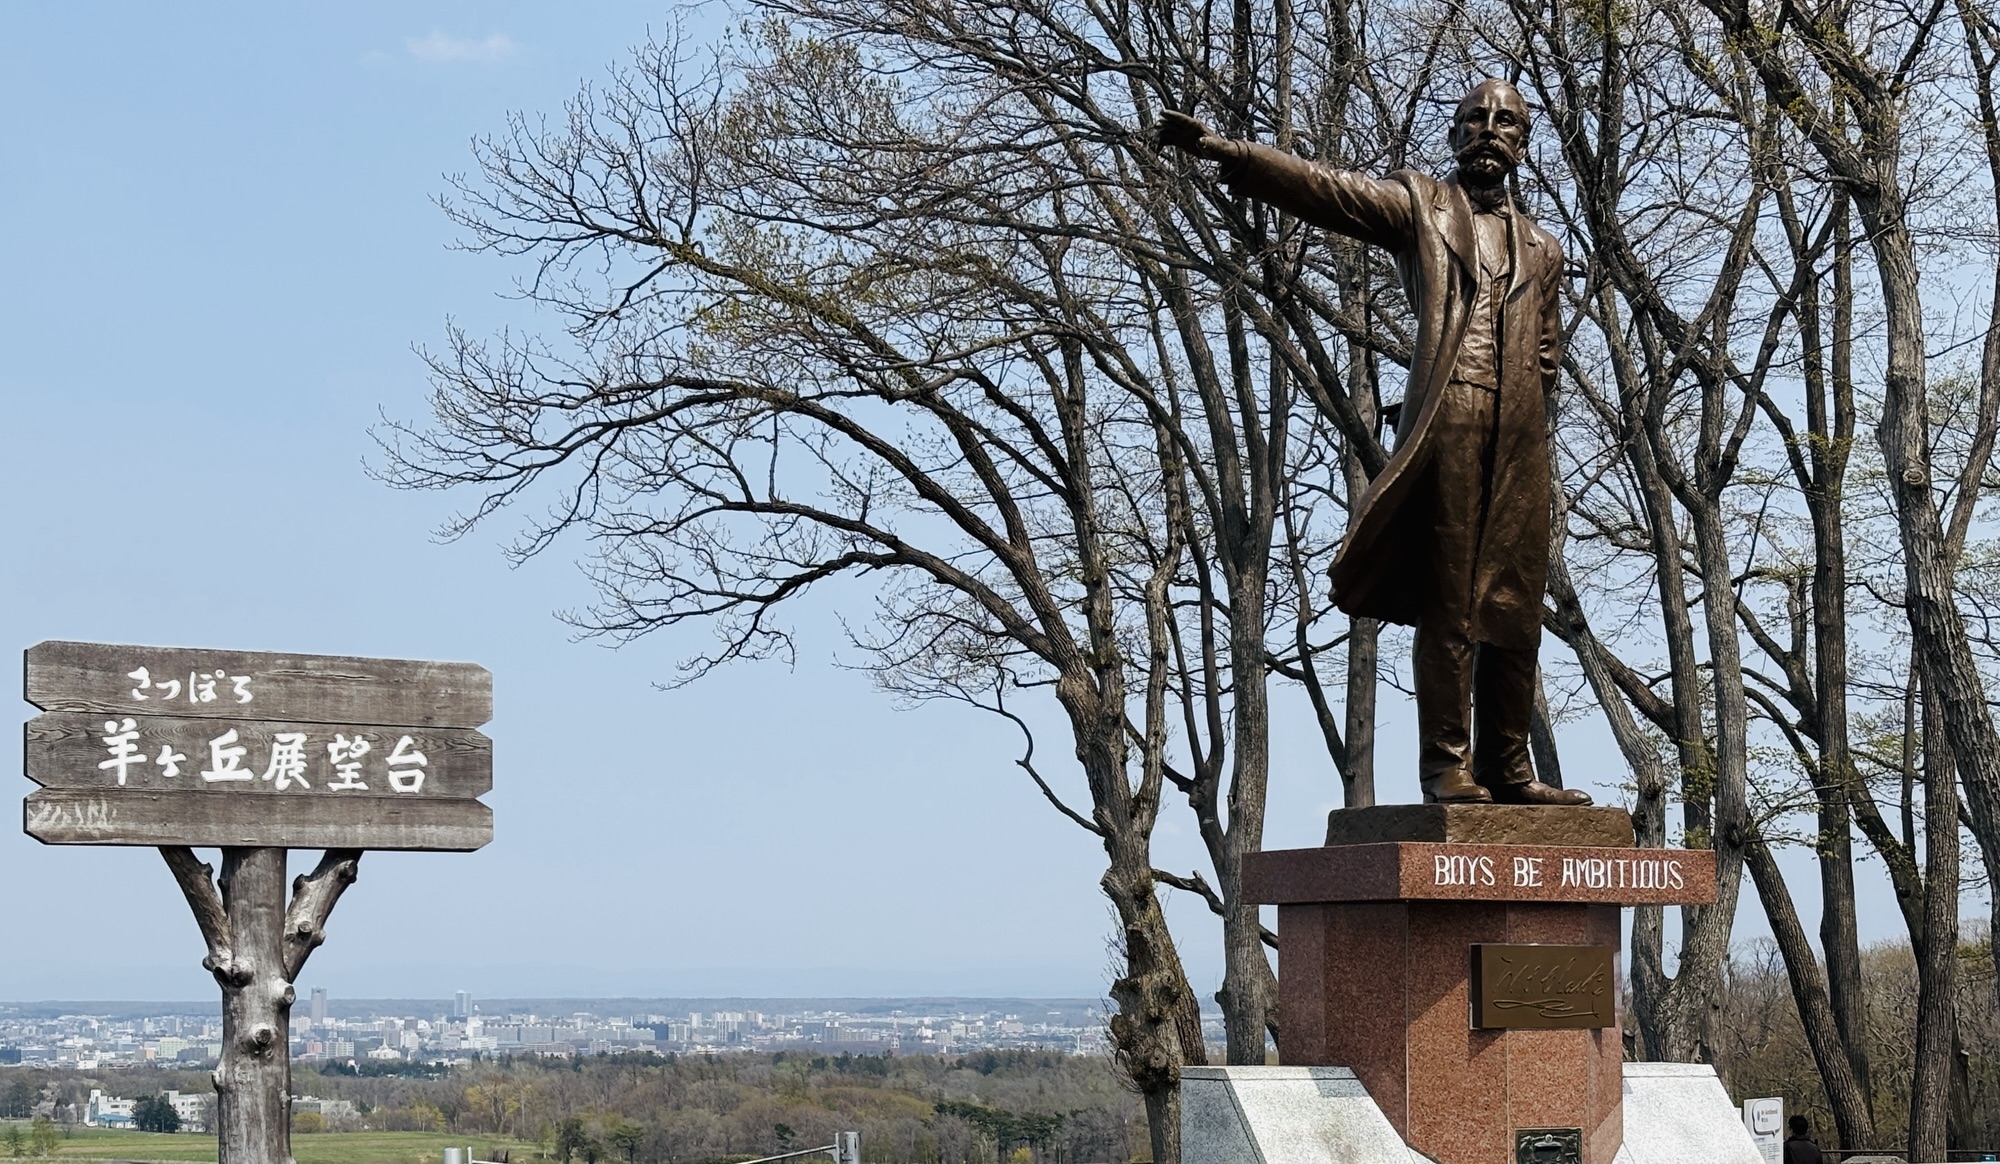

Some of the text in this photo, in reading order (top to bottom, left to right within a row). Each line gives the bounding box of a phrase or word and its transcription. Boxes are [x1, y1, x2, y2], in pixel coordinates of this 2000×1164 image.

[1434, 855, 1684, 890] BOYS BE AMBITIOUS
